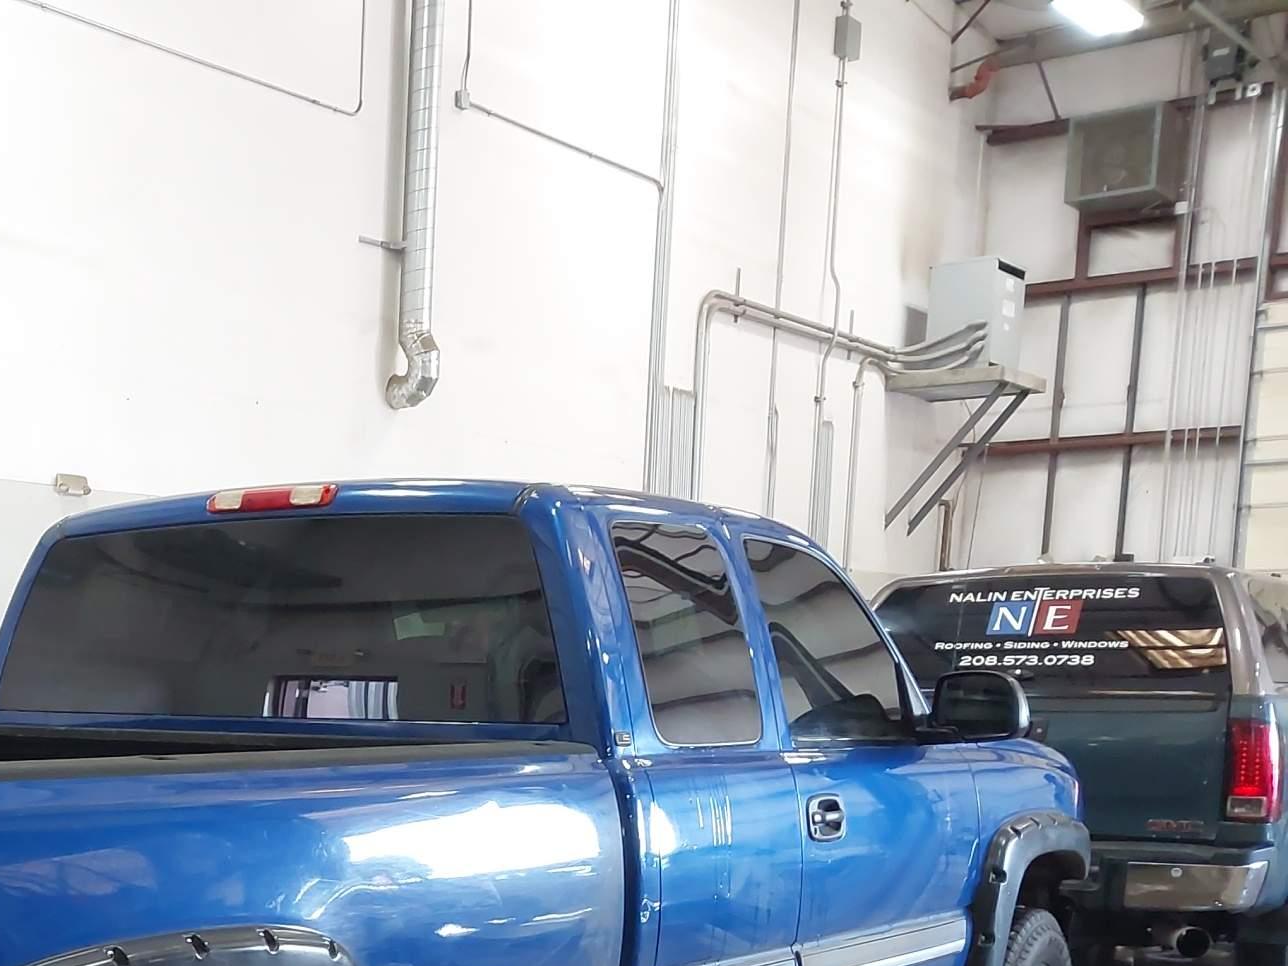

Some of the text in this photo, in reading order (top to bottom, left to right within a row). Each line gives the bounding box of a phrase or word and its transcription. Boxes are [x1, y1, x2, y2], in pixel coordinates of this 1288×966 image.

[949, 587, 1141, 603] NALIN ENTERPRISES
[992, 604, 1072, 631] N E
[934, 640, 1129, 650] ROOFING SIDING WINDOWS
[958, 654, 1095, 667] 208.573.0738
